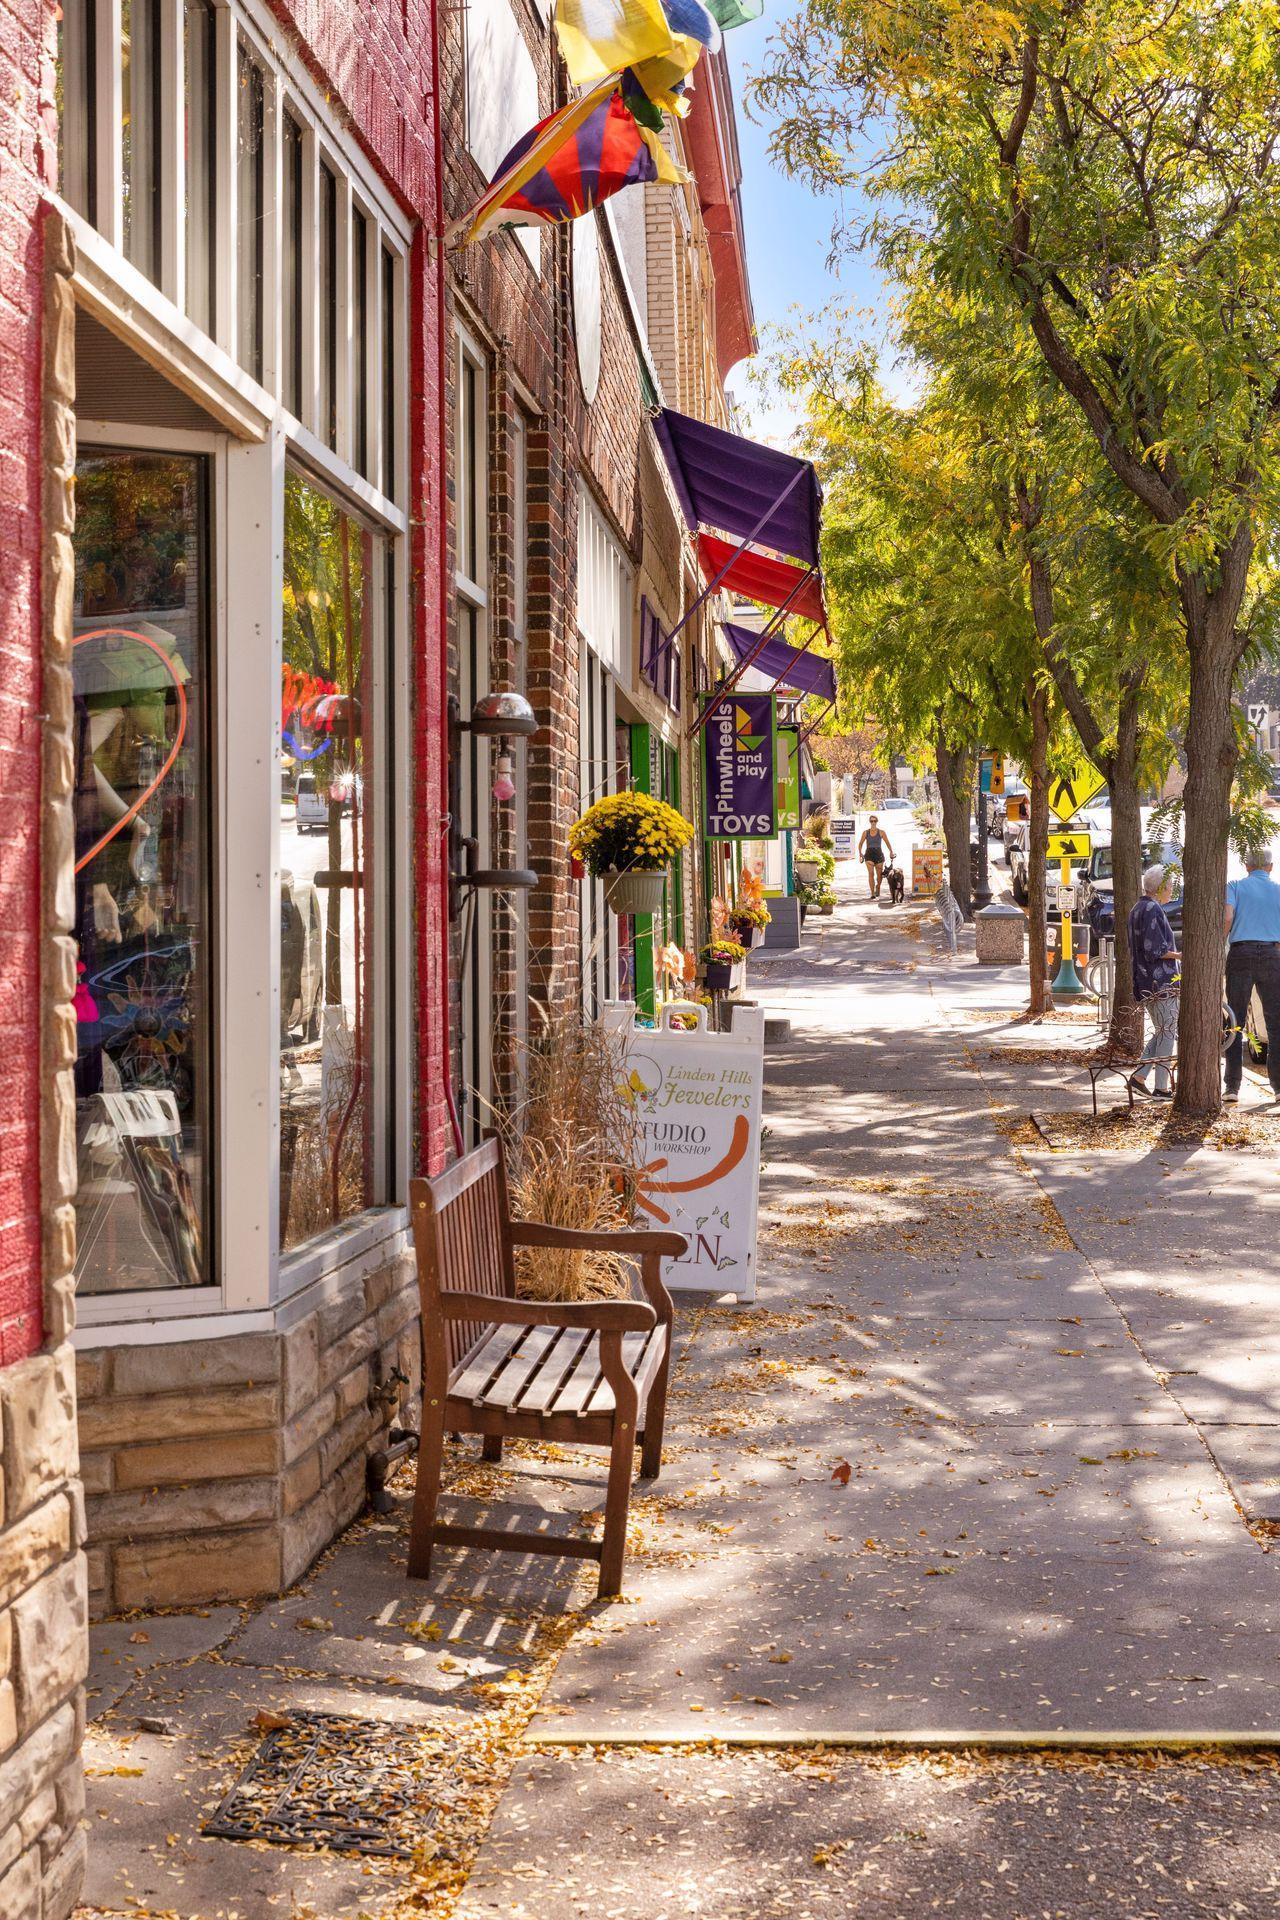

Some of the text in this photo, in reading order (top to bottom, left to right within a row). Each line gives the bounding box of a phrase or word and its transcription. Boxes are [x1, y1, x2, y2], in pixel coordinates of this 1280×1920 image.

[711, 703, 733, 813] Pinwheels
[737, 753, 762, 763] and
[737, 765, 767, 779] Play
[709, 814, 771, 834] TOYS
[666, 1065, 752, 1084] Linden Hills
[658, 1082, 751, 1108] Jewelers
[654, 1142, 711, 1155] WORKSHOP
